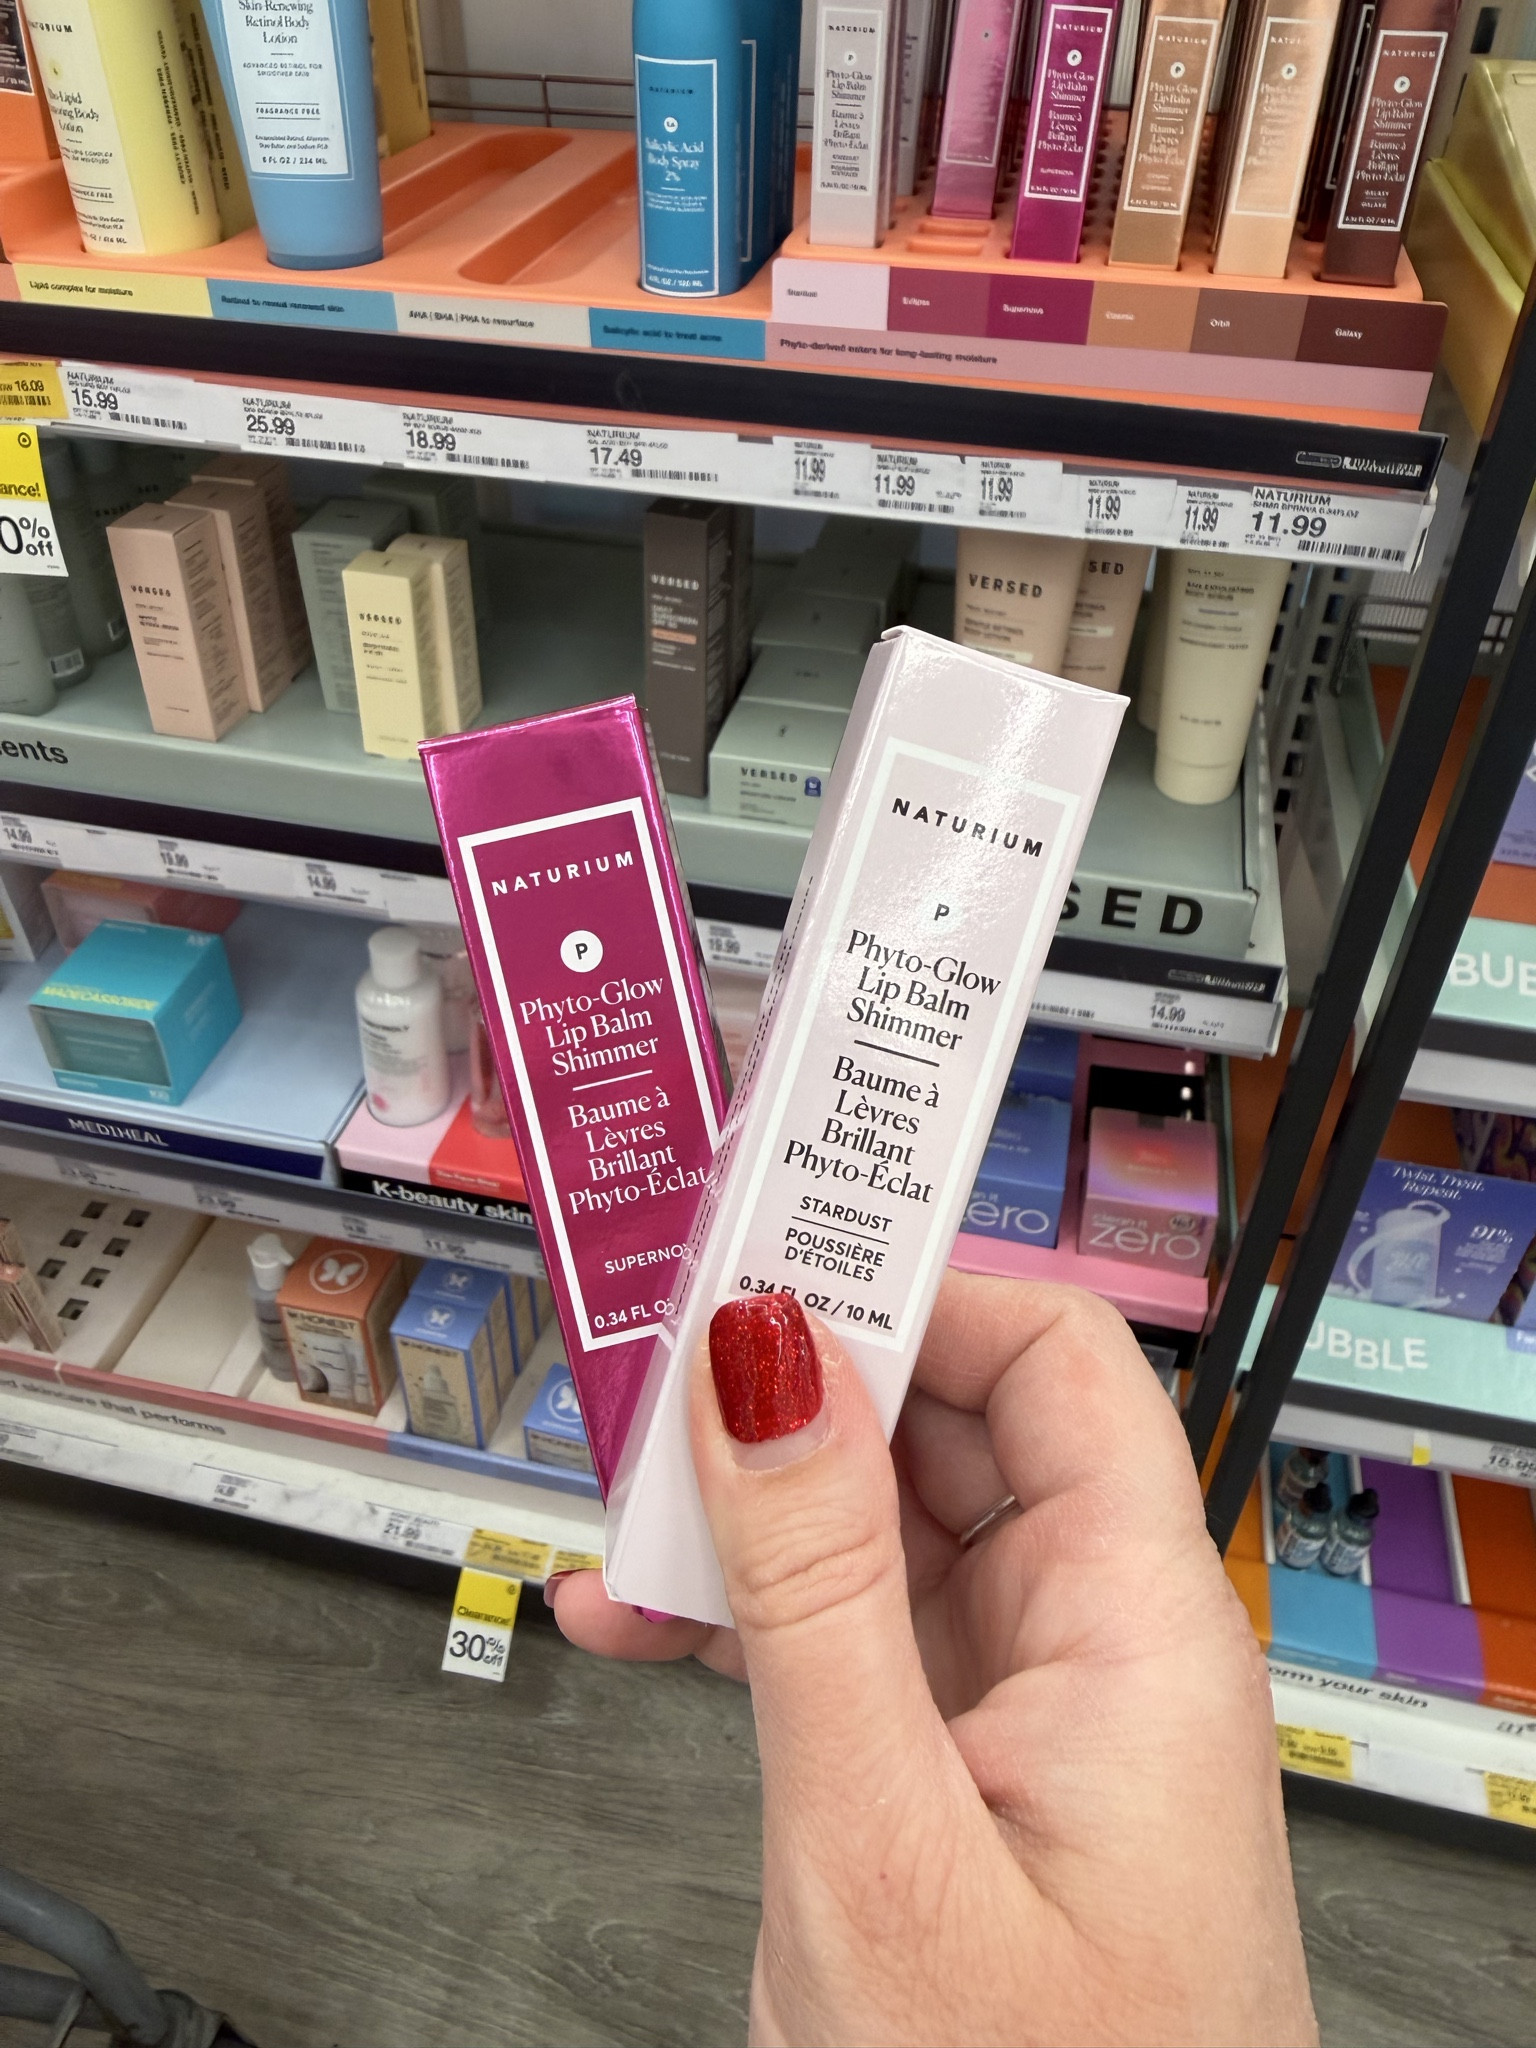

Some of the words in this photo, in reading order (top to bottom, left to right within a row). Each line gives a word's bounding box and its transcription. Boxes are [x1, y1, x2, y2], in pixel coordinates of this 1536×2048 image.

[828, 25, 876, 34] NATURIUM
[1055, 23, 1103, 33] NATURIUM
[1383, 50, 1436, 58] NATURIUM
[1334, 327, 1363, 341] Galaxy
[71, 388, 119, 411] 15.99
[246, 413, 296, 436] 25.99
[405, 428, 457, 452] 18.99
[590, 446, 643, 468] 17.49
[794, 457, 826, 483] 11.99
[874, 473, 916, 497] 11.99
[980, 476, 1014, 503] 11.99
[1254, 488, 1332, 507] NATURIUM
[1087, 494, 1121, 521] 11.99
[1184, 505, 1220, 533] 11.99
[1252, 510, 1327, 539] 11.99
[25, 540, 54, 558] off
[651, 573, 700, 591] VERSED
[968, 573, 1043, 598] VERSED
[3, 741, 70, 766] ents
[740, 766, 798, 784] VERSED
[892, 797, 1044, 858] NATURIUM
[491, 850, 635, 896] NATURIUM
[933, 903, 950, 921] P
[575, 942, 589, 961] P
[846, 929, 1002, 996] Phyto-Glow
[520, 977, 665, 1026] Phyto-Glow
[857, 965, 901, 1005] Lip
[904, 979, 970, 1021] Balm
[545, 1022, 588, 1049] Lip
[590, 1008, 653, 1039] Balm
[847, 996, 963, 1051] Shimmer
[1150, 1004, 1186, 1024] 14.99
[551, 1036, 660, 1077] Shimmer
[832, 1055, 922, 1102] Baume
[924, 1082, 941, 1109] à
[567, 1091, 653, 1129] Baume
[656, 1086, 672, 1109] à
[834, 1088, 921, 1135] Lèvres
[67, 1117, 169, 1147] MEDIHEAL
[585, 1119, 667, 1155] Lèvres
[821, 1117, 916, 1167] Brillant
[588, 1144, 677, 1183] Brillant
[783, 1139, 935, 1204] Phyto-Éclat
[372, 1179, 479, 1216] K-beauty
[484, 1203, 534, 1225] skin
[568, 1166, 709, 1216] Phyto-Éclat
[799, 1195, 893, 1233] STARDUST
[963, 1200, 1050, 1234] ero
[785, 1226, 886, 1268] POUSSIÈRE
[1089, 1221, 1201, 1261] zero
[1470, 1225, 1514, 1245] 91%
[604, 1244, 684, 1275] SUPERNO
[784, 1245, 876, 1283] D'ÉTOILES
[593, 1312, 629, 1330] 0.34
[631, 1303, 652, 1321] FL
[654, 1299, 669, 1316] O
[739, 1275, 776, 1295] 0.34
[803, 1291, 831, 1314] OZ
[830, 1299, 846, 1316] /
[846, 1303, 866, 1323] 10
[868, 1309, 894, 1331] ML
[100, 1399, 138, 1416] that
[140, 1409, 226, 1435] performs
[1319, 1676, 1374, 1696] your
[1378, 1689, 1429, 1710] skin
